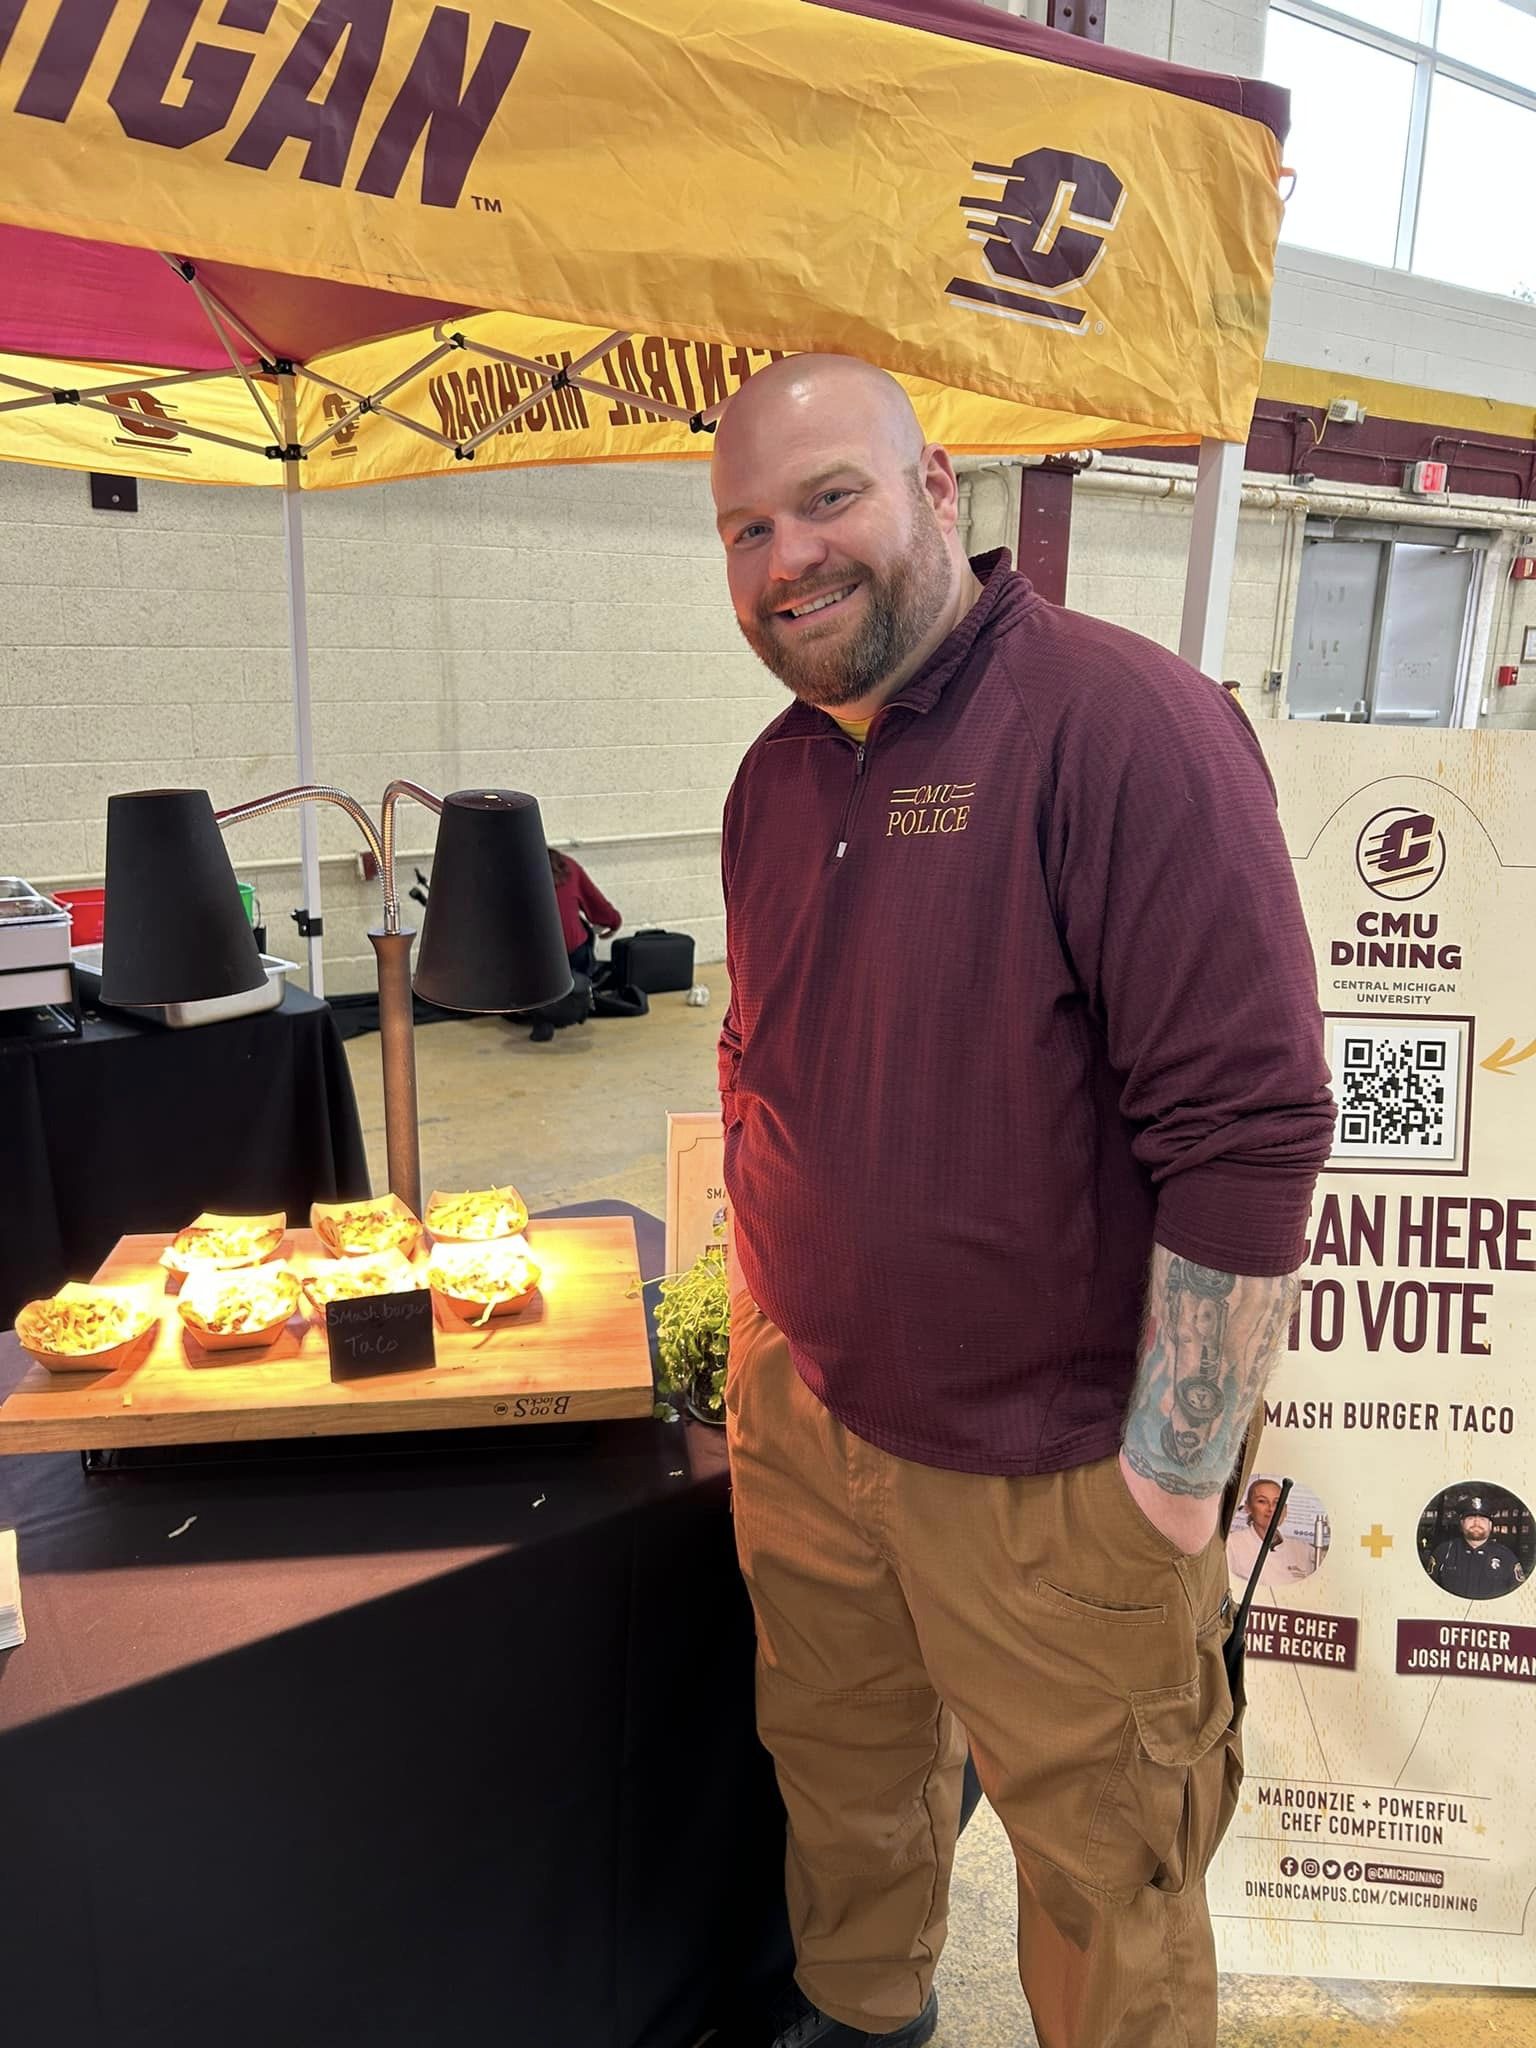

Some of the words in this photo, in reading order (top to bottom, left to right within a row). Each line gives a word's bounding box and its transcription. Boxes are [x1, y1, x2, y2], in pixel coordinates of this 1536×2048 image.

[0, 0, 531, 208] IGAN
[471, 196, 502, 213] TM
[914, 784, 957, 806] CMU
[886, 805, 971, 837] POLICE
[1356, 911, 1439, 939] CMU
[1330, 941, 1462, 970] DINING
[1333, 980, 1389, 991] CENTRAL
[1393, 982, 1456, 993] MICHIGAN
[1357, 993, 1431, 1005] UNIVERSITY
[1303, 1194, 1387, 1267] AN
[1398, 1195, 1536, 1271] HERE
[1357, 1280, 1494, 1355] VOTE
[1343, 1402, 1439, 1430] BURGER
[1449, 1404, 1514, 1434] TACO
[1294, 1617, 1339, 1640] CHEF
[1439, 1626, 1511, 1650] OFFICER
[1282, 1636, 1346, 1663] RECKER
[1408, 1649, 1450, 1669] JOSH
[1258, 1786, 1355, 1812] MAROONZIE
[1379, 1797, 1468, 1823] POWERFUL
[1281, 1812, 1322, 1832] CHEF
[1329, 1815, 1443, 1844] COMPETITION
[1367, 1866, 1442, 1885] @CMICHDINING
[1245, 1880, 1478, 1912] DINEONCAMPUS.COM/CMICHDINING
